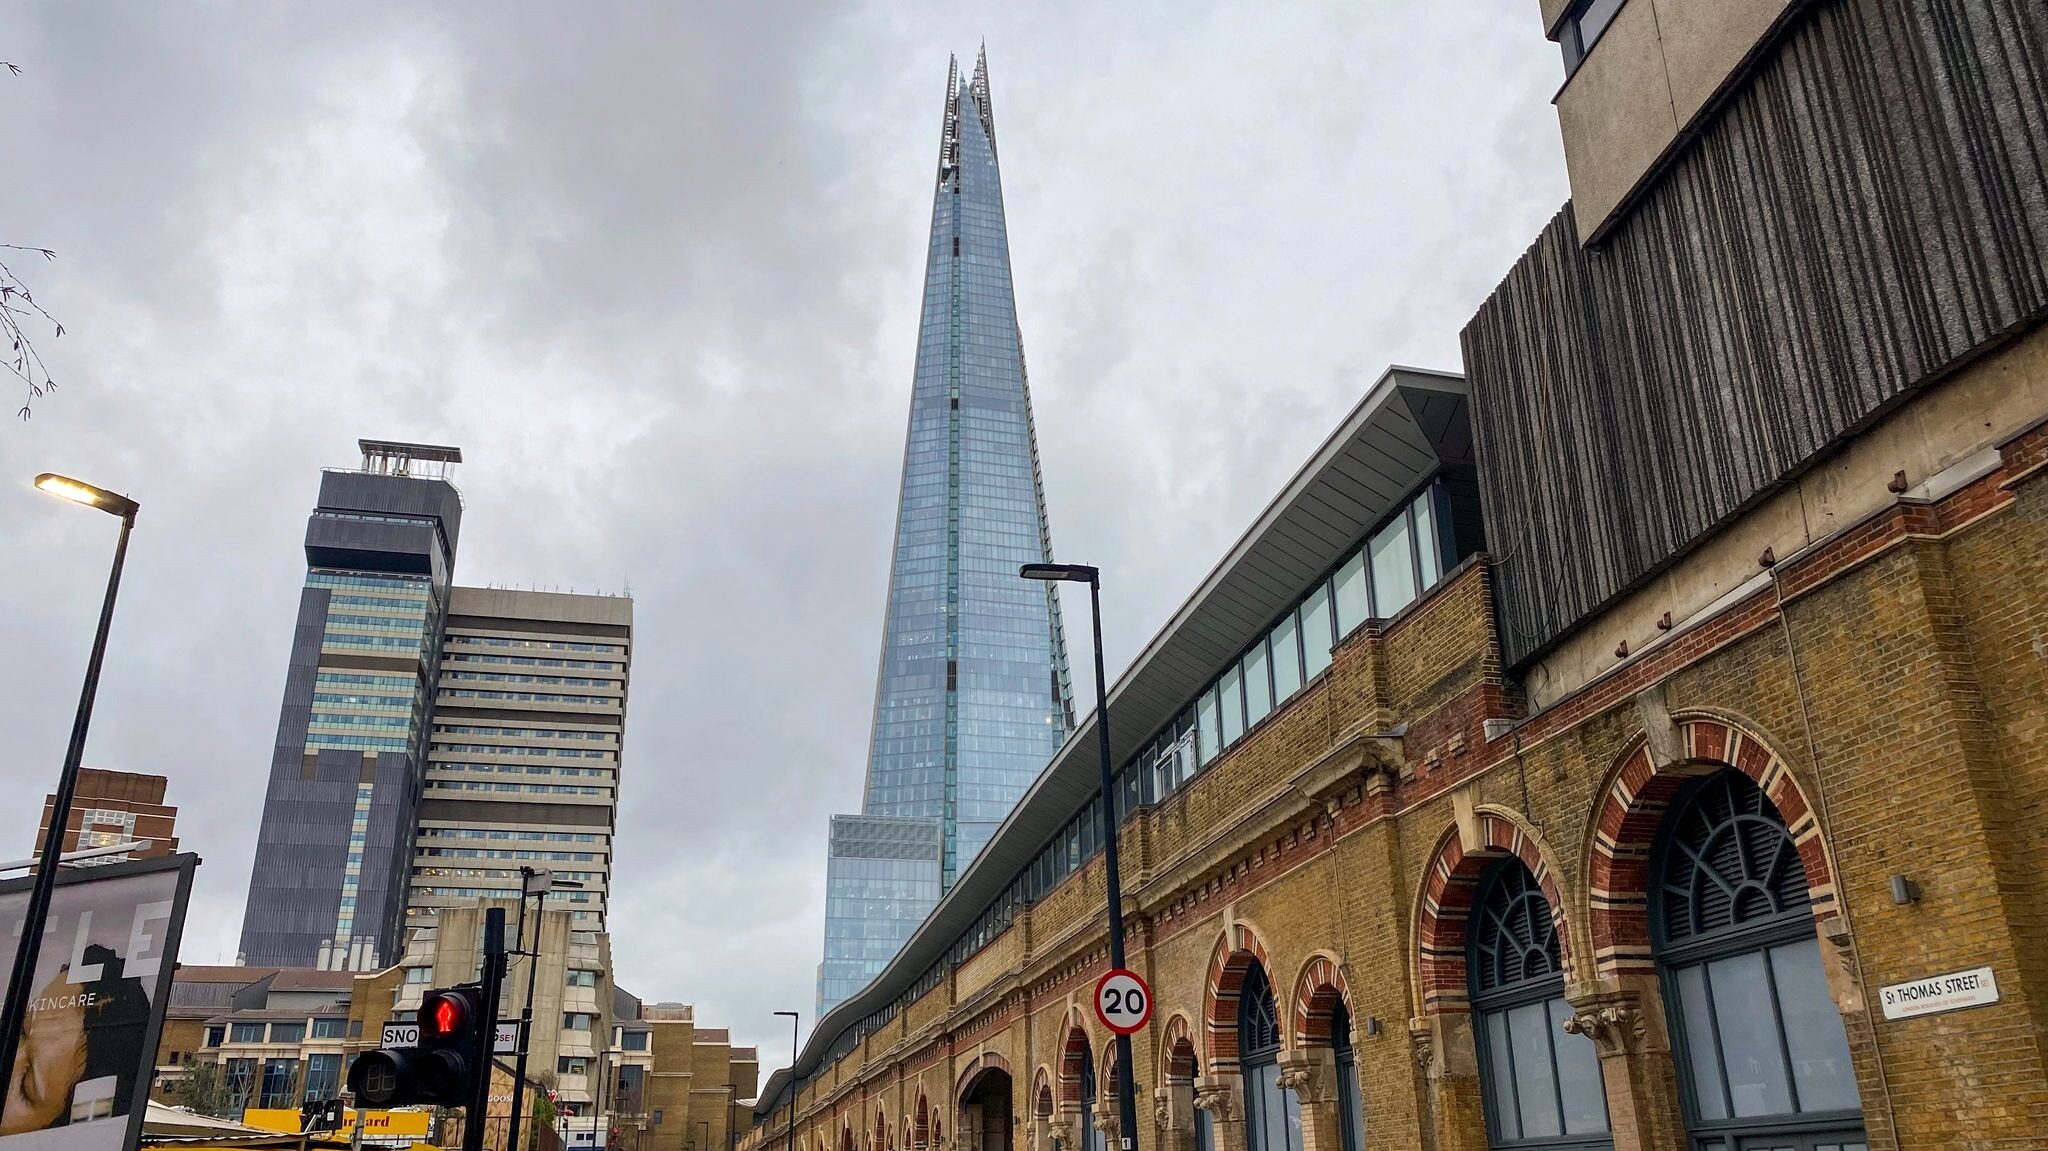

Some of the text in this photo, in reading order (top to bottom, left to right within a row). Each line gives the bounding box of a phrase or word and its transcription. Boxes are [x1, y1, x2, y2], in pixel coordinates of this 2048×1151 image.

[1885, 991, 1896, 1004] St
[1897, 982, 1942, 1002] THOMAS
[1945, 975, 1980, 994] STREET
[28, 992, 96, 1011] KINCARE
[1104, 989, 1144, 1014] 20
[384, 1029, 418, 1043] SNO
[365, 1116, 390, 1127] ard
